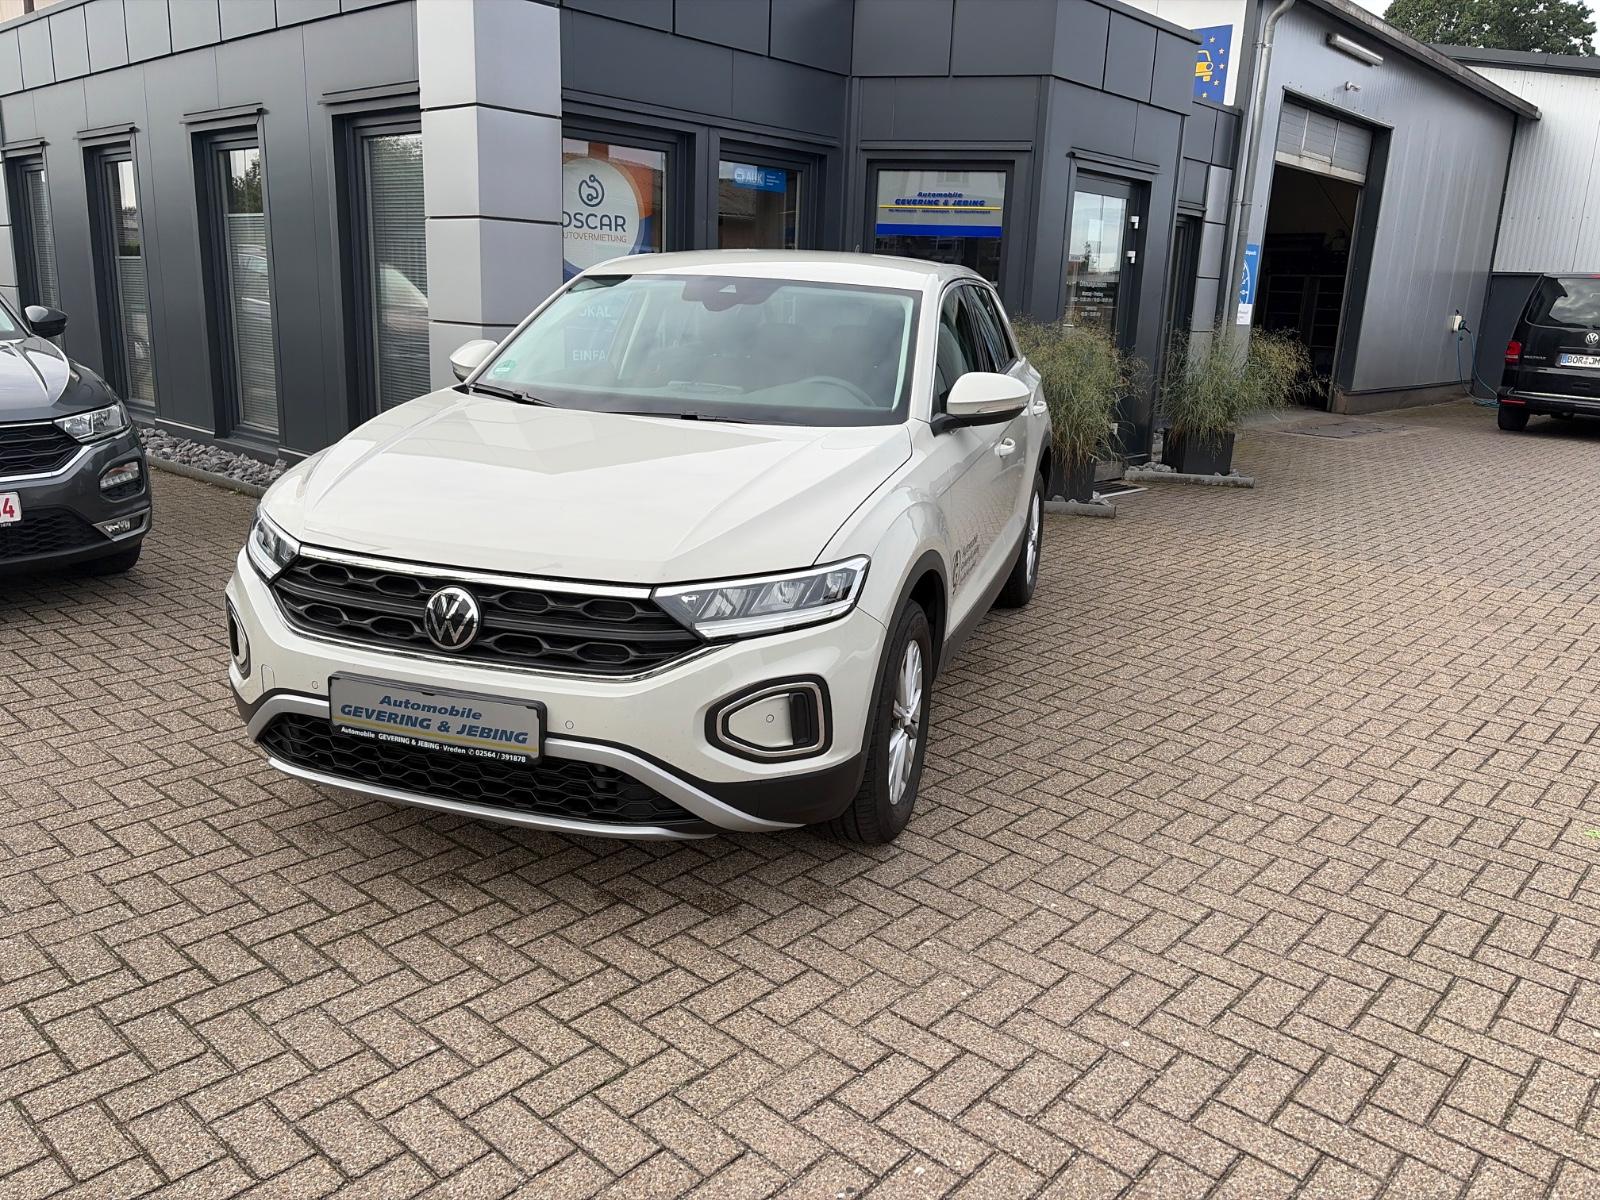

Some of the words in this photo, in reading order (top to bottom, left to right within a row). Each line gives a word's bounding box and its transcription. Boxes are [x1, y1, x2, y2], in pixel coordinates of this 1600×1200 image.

[894, 198, 940, 206] GEVERING
[952, 199, 986, 207] JEBING
[563, 231, 627, 243] UTOVERMIETUNG
[572, 350, 608, 361] EINFA
[1568, 356, 1584, 365] BOR
[0, 498, 14, 518] 4
[379, 695, 482, 720] Automobile
[340, 704, 432, 730] GEVERING
[437, 720, 451, 733] &
[456, 724, 529, 744] JEBING
[341, 726, 375, 739] Automobile
[378, 733, 410, 744] GEVERING
[417, 739, 440, 750] JEBING
[442, 745, 466, 754] Vreden
[475, 750, 496, 758] 02564
[500, 753, 526, 763] 391878
